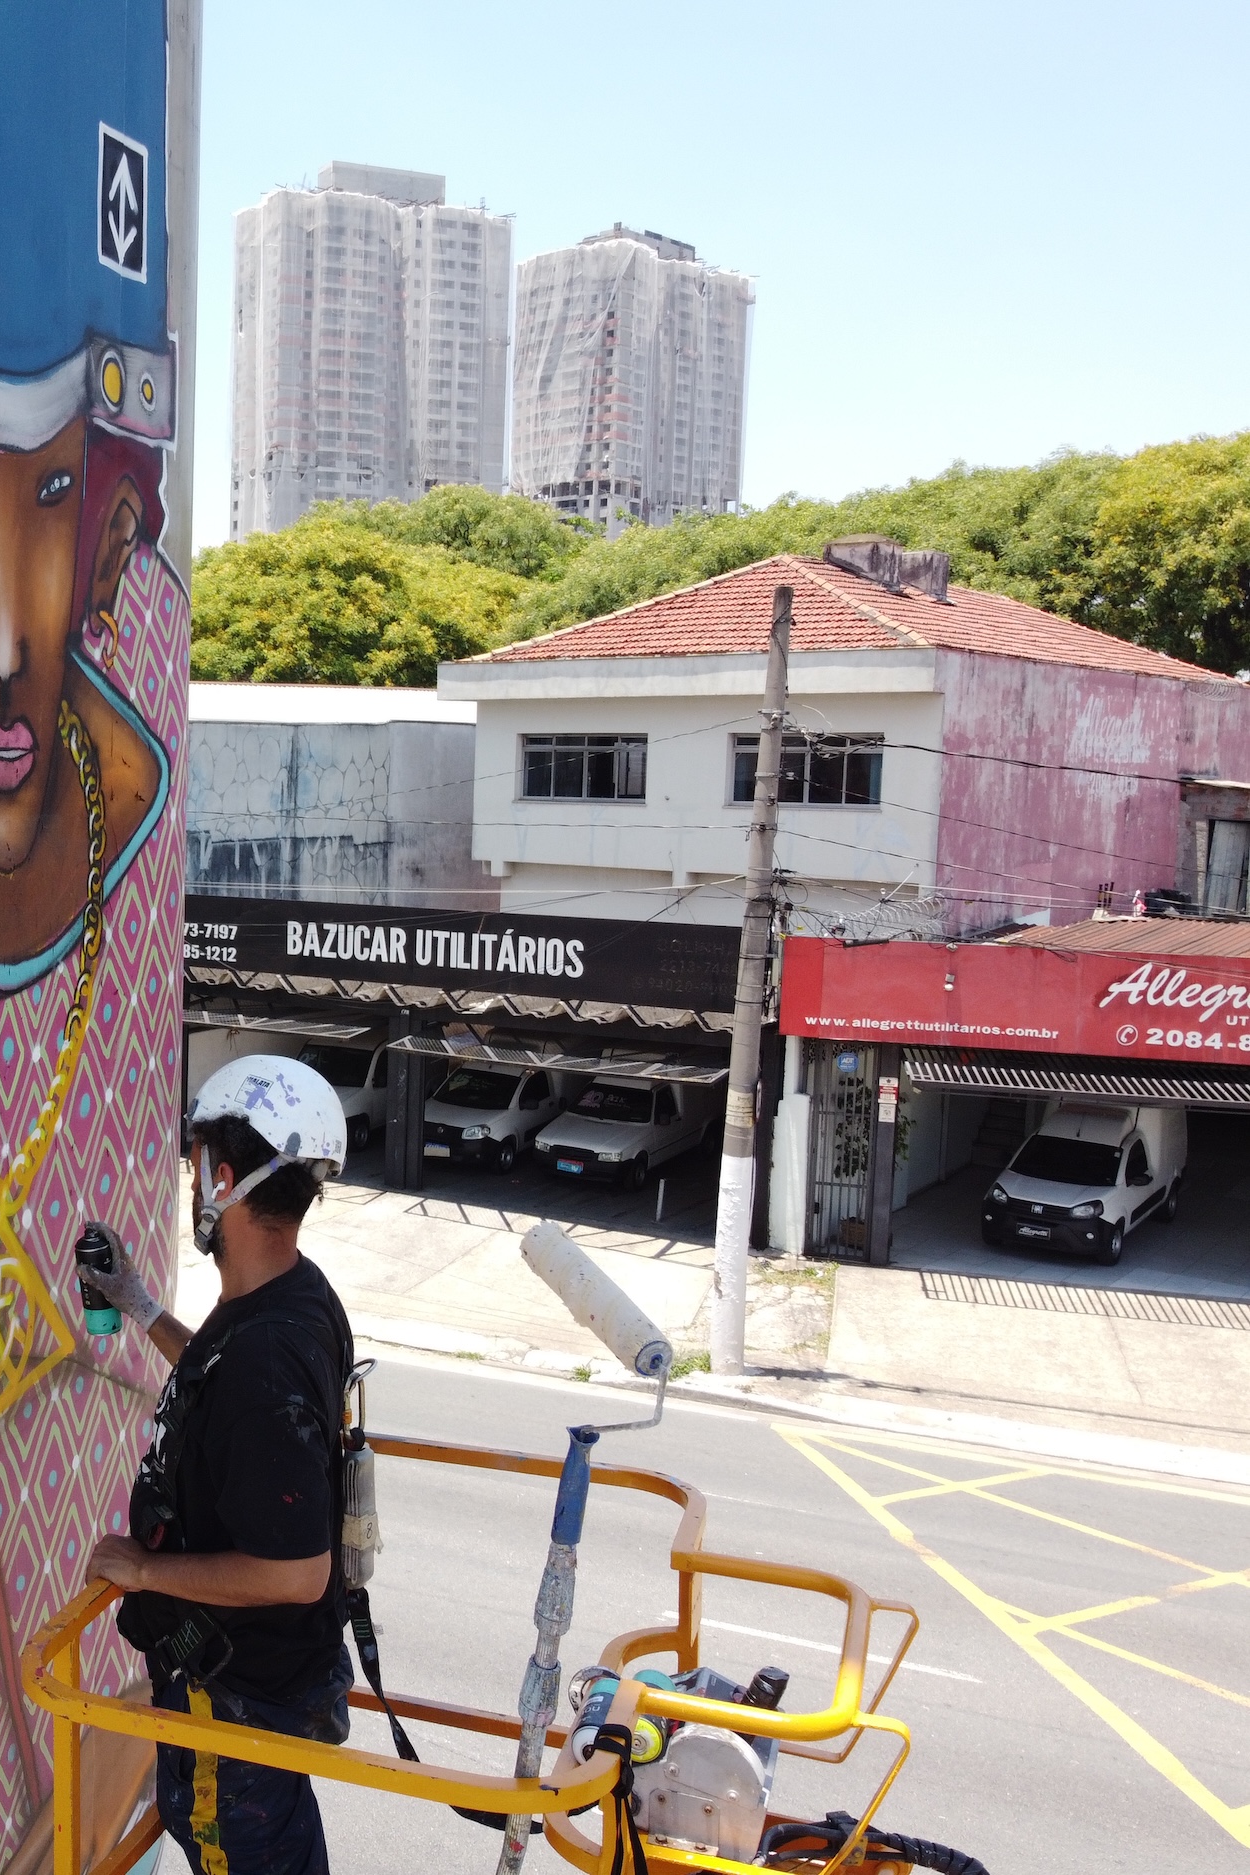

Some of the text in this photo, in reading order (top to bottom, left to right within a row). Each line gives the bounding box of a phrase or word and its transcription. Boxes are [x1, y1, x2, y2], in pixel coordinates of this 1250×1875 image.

[287, 920, 584, 978] BAZUCAR UTILITÁRIOS
[1098, 962, 1250, 1023] Allegr
